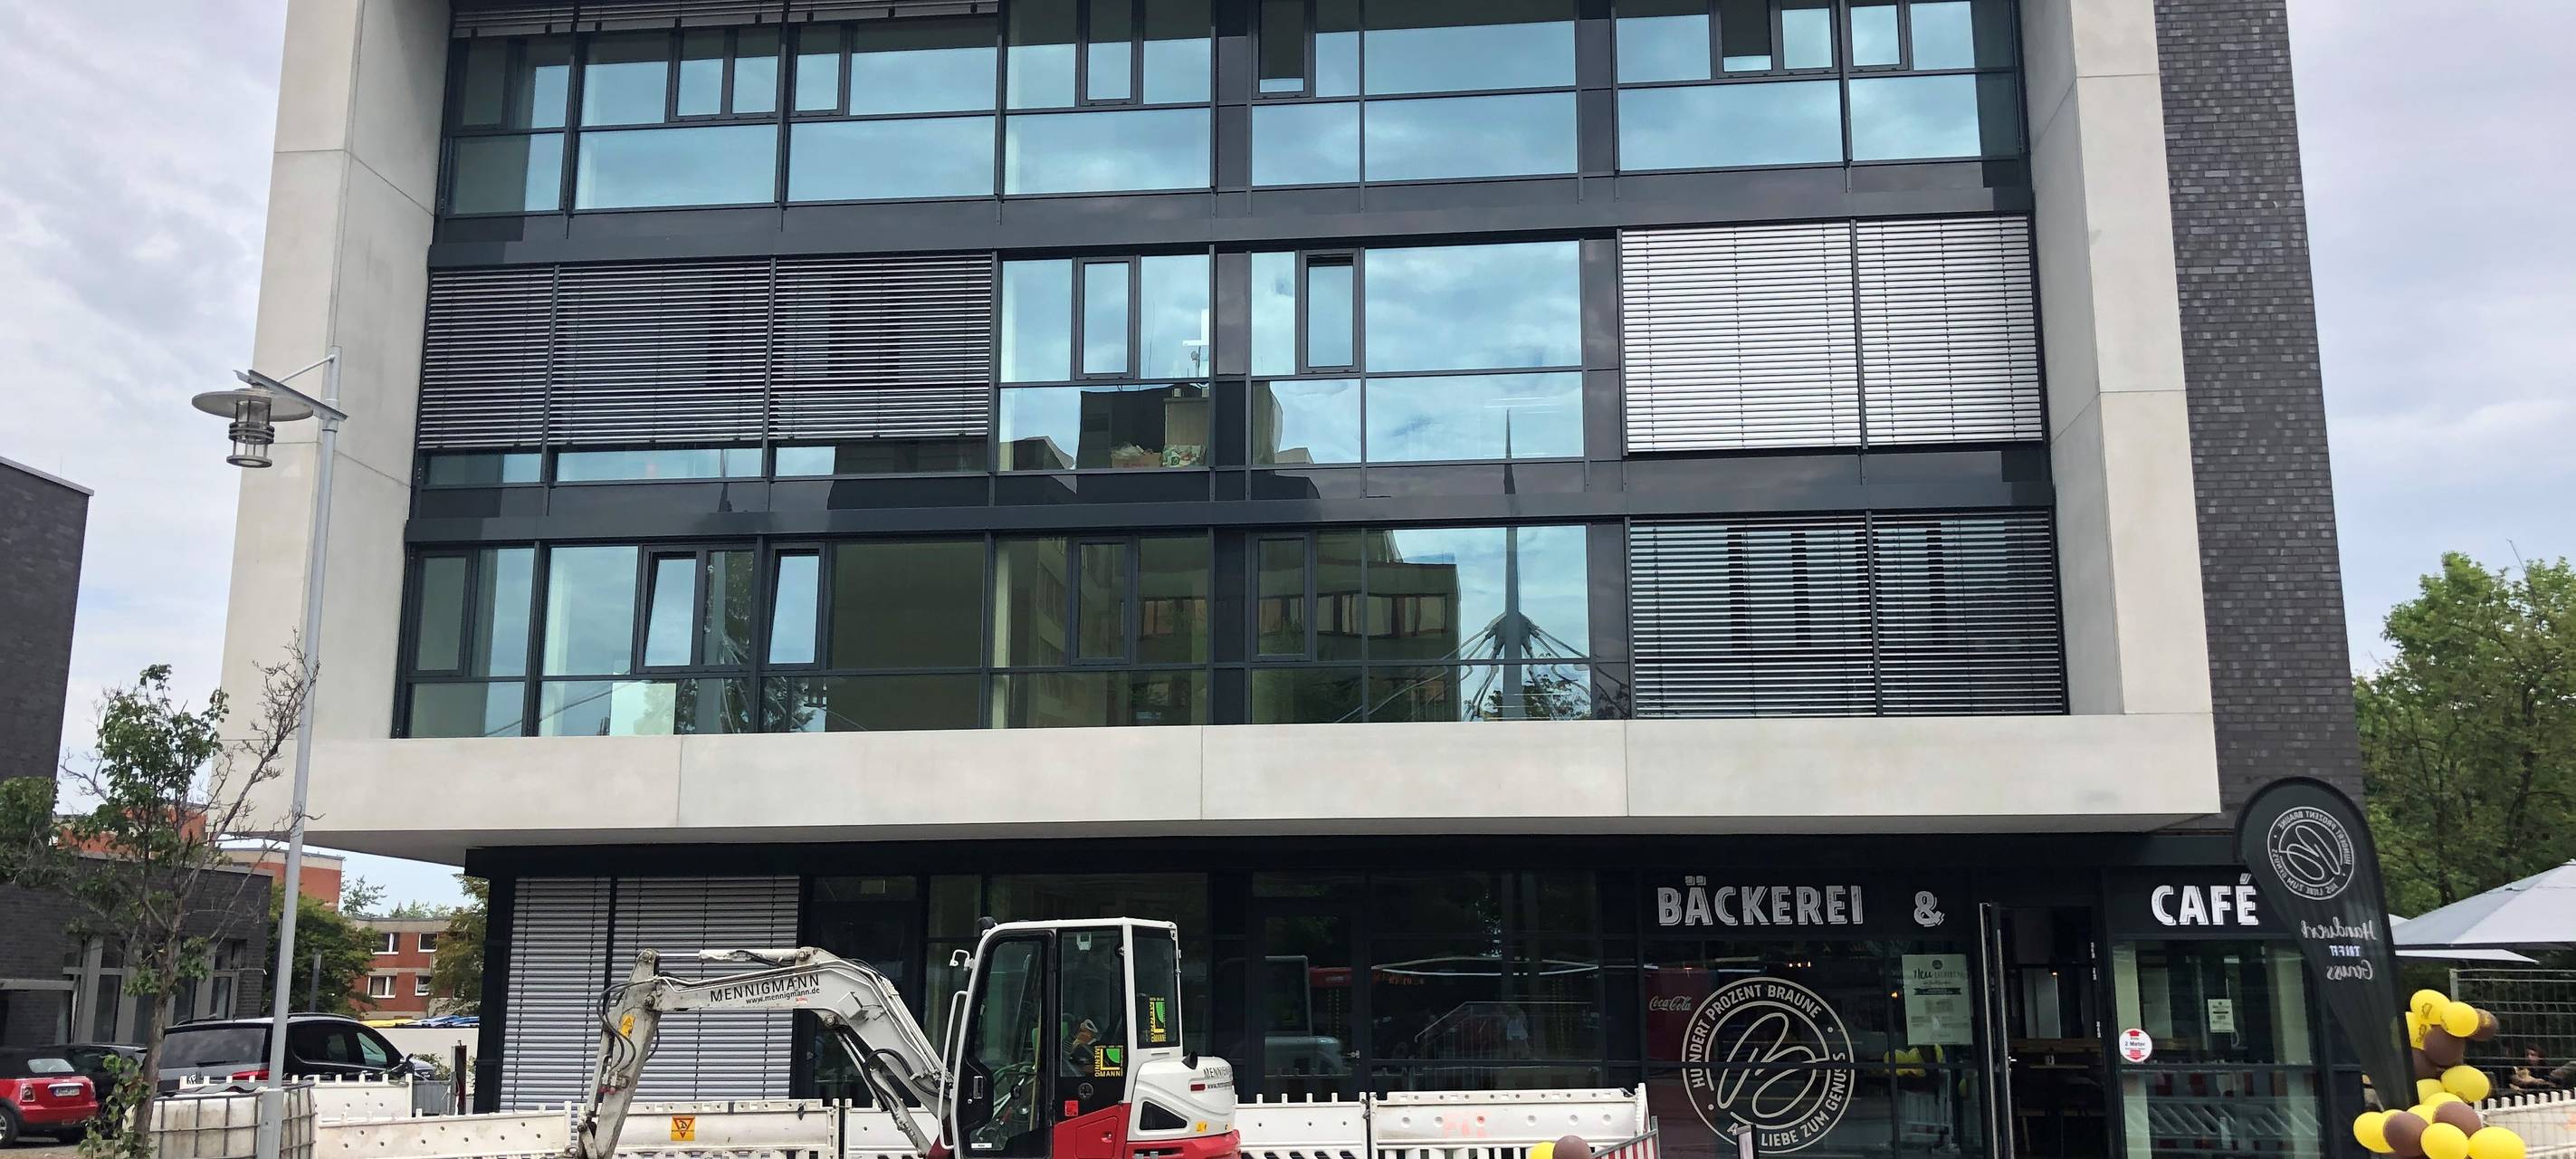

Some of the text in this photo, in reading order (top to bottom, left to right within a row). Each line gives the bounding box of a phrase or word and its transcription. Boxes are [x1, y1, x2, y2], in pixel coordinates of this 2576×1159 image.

[1657, 873, 2259, 927] BÄCKEREI & CAFÉ
[710, 973, 820, 1002] MENNIGMANN
[745, 987, 820, 1004] www.mennigmann.de
[1689, 984, 1822, 1087] HUNDERT PROZENT BRAUNE
[1760, 1130, 1799, 1146] LIEBE
[1799, 1110, 1830, 1137] ZUM
